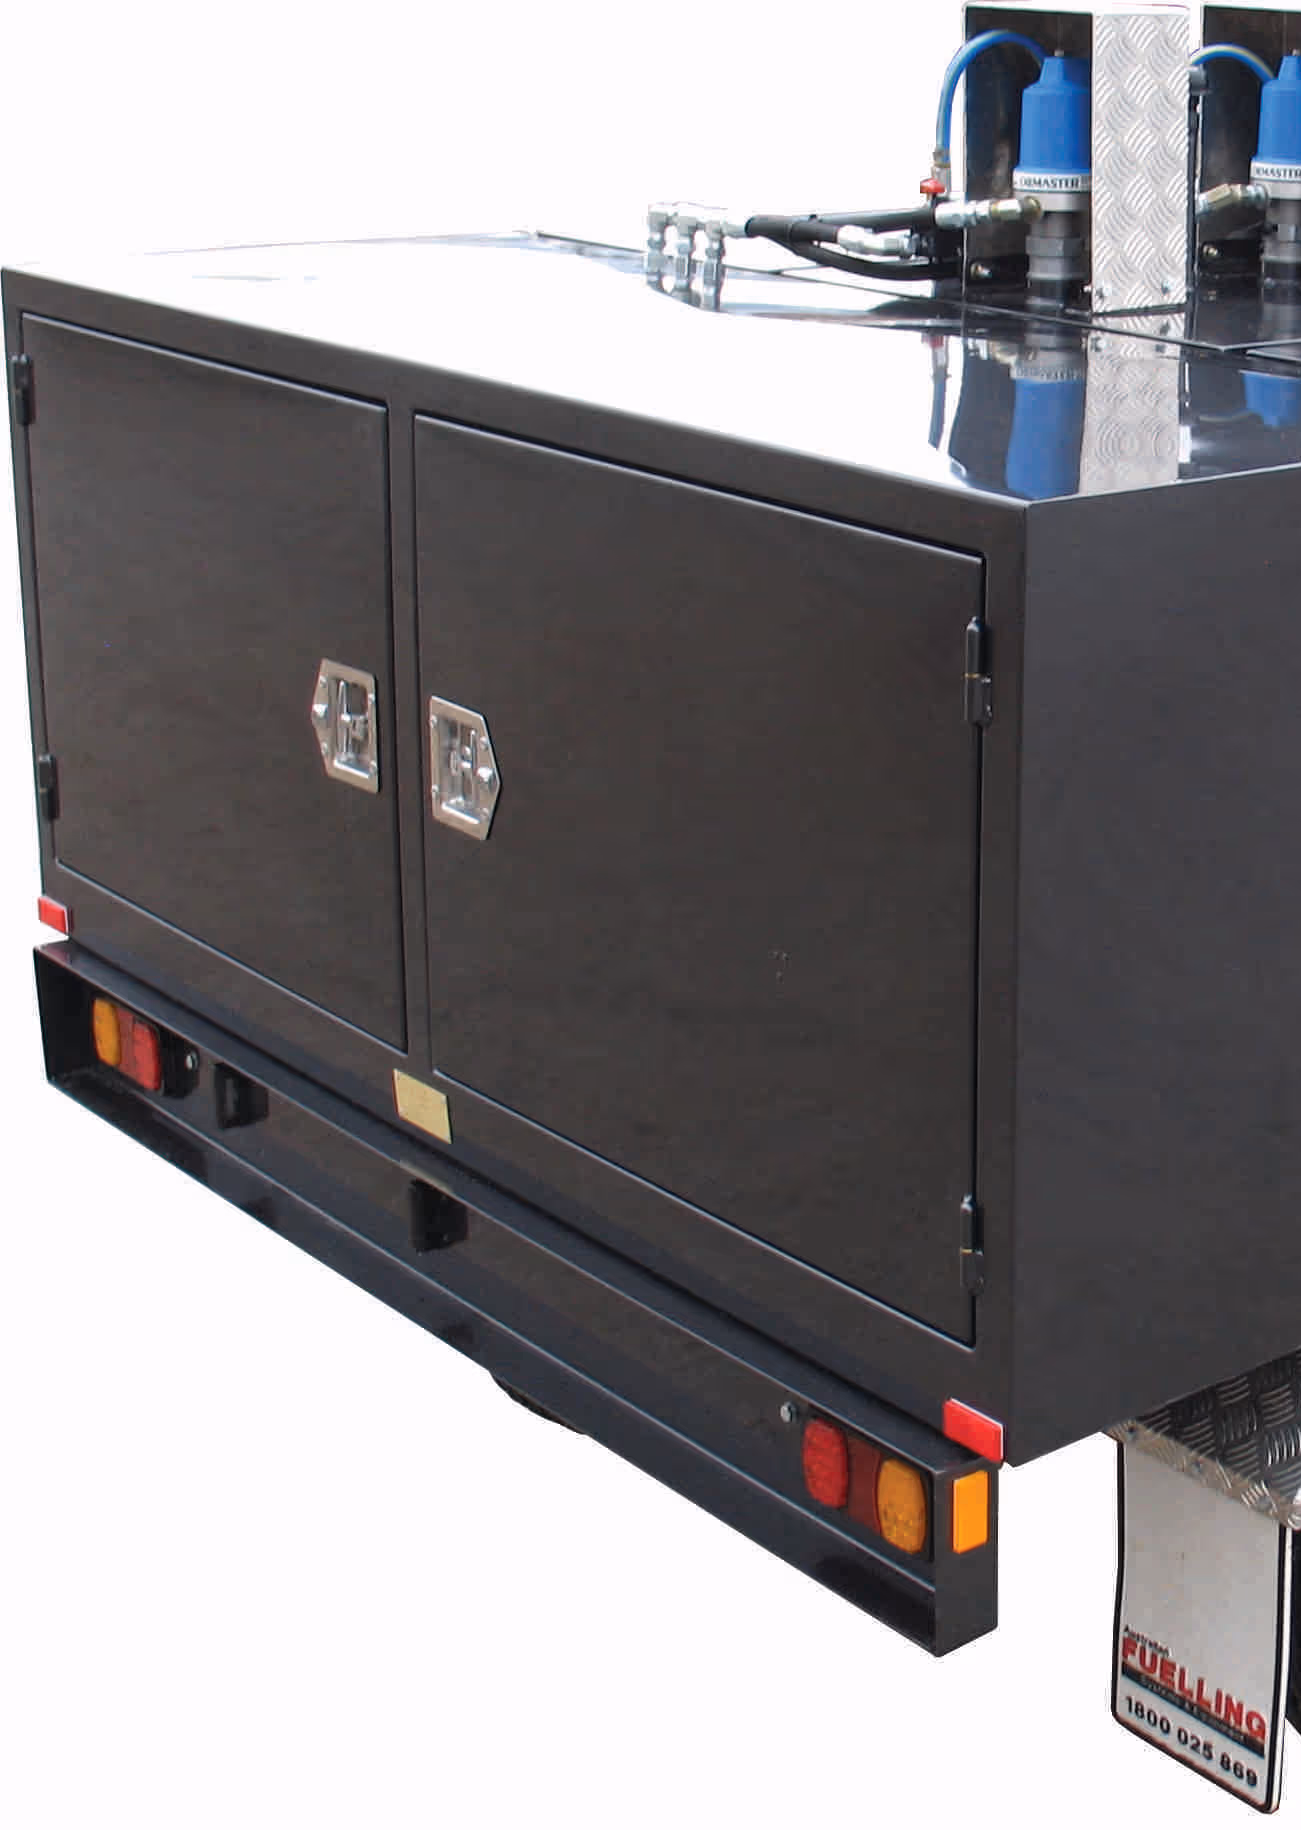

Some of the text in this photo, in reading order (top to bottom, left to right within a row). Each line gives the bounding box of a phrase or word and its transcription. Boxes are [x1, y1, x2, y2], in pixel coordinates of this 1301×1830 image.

[1122, 1636, 1267, 1739] FUELLING
[1126, 1696, 1257, 1787] 1800 025 869
